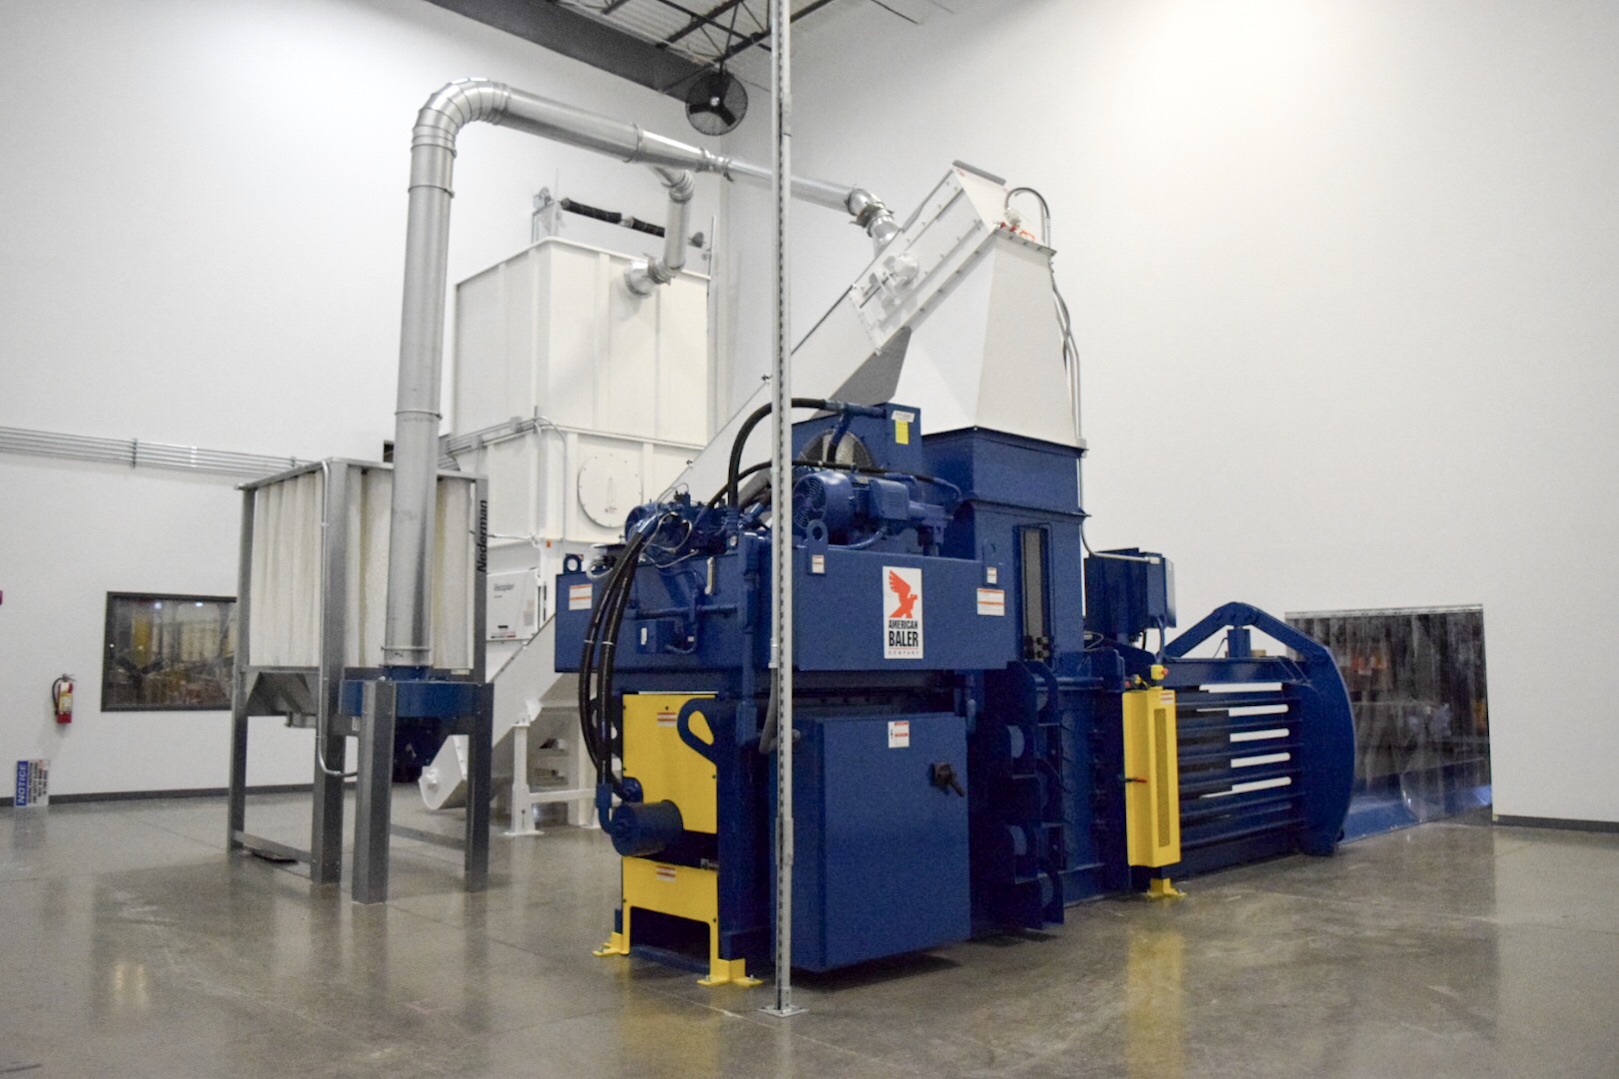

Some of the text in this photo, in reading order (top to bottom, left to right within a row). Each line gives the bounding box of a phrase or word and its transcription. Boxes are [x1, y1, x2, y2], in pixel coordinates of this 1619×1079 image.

[476, 500, 487, 573] Nederman
[889, 620, 918, 629] AMERICAN
[889, 631, 918, 647] BALER
[17, 763, 26, 804] NOTICE
